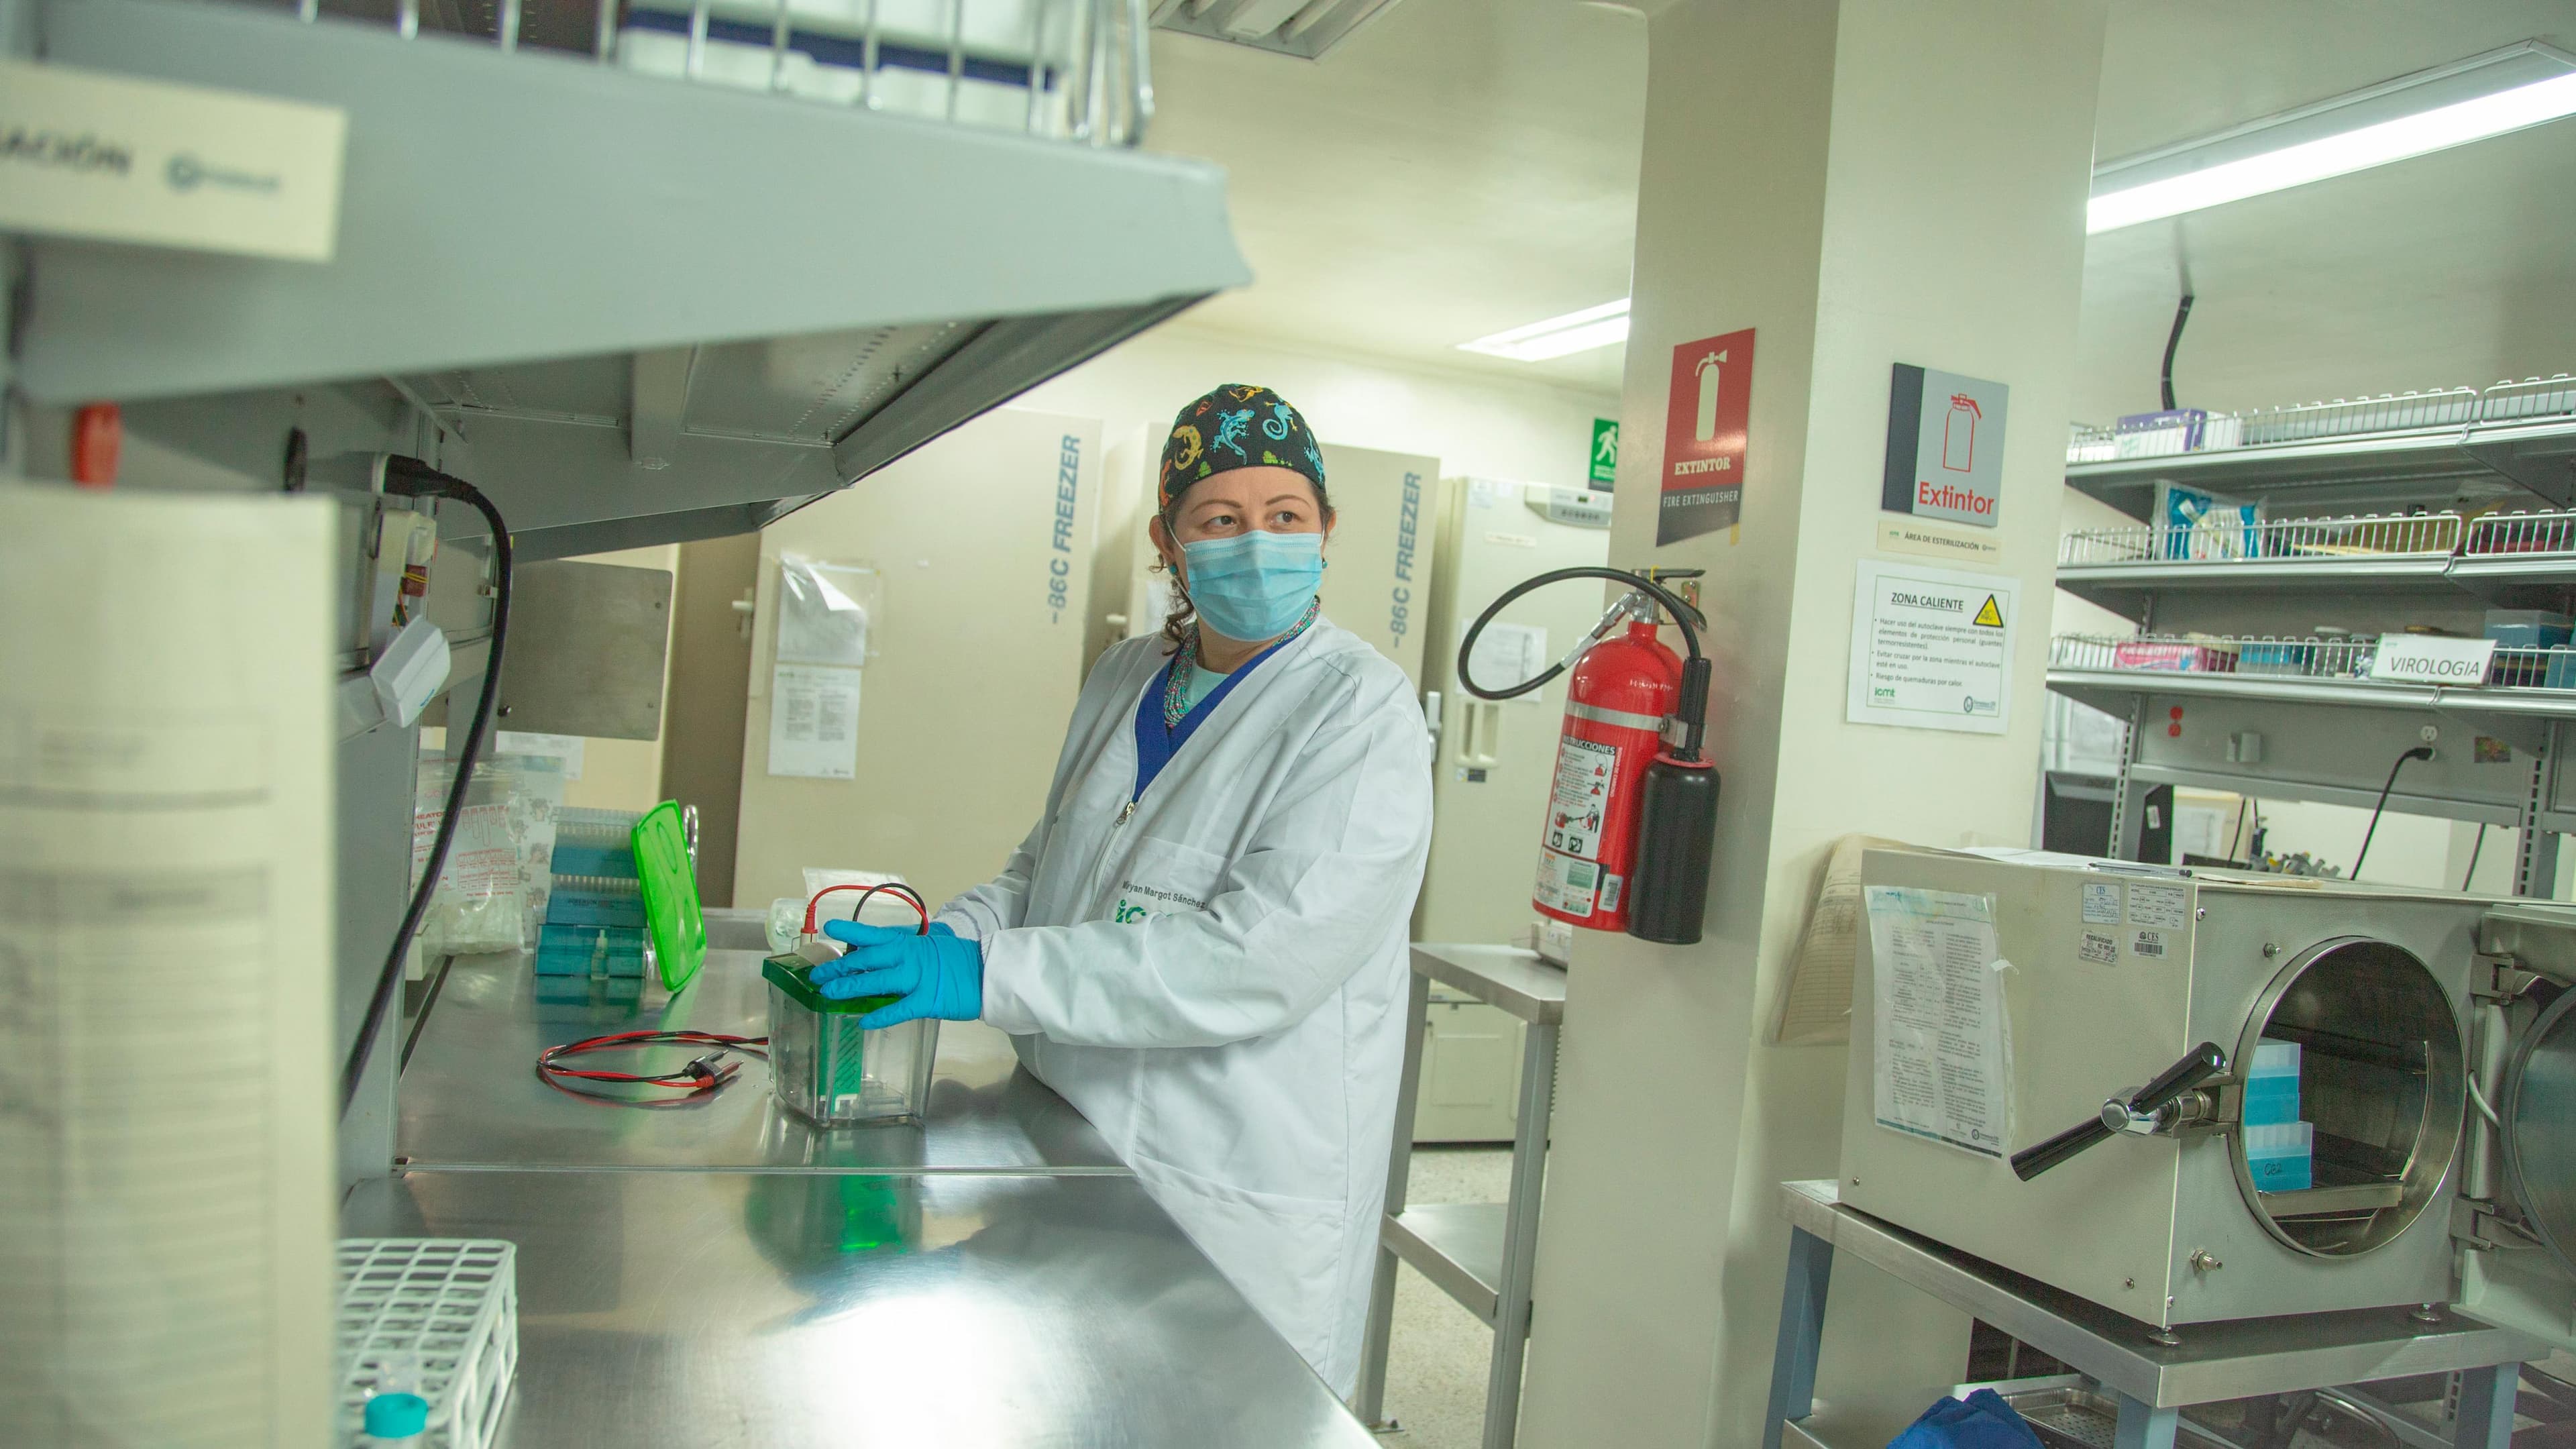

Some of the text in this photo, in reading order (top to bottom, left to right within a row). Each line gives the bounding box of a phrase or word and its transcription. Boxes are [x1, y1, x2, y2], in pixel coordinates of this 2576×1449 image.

[1674, 457, 1731, 476] EXTINTOR
[1052, 433, 1081, 553] FREEZER
[1663, 490, 1739, 508] FIRE EXTINGUISHER
[1918, 481, 1995, 515] Extintor
[1395, 472, 1422, 582] FREEZER
[1904, 531, 1921, 542] ÁREA
[1923, 536, 1931, 544] DE
[1932, 538, 1980, 551] ESTERILIZACIÓN
[1891, 592, 1964, 610] ZONA CALIENTE
[1878, 629, 1907, 637] elementos
[1921, 633, 1949, 642] protección
[1979, 639, 2002, 647] (guantes
[1945, 626, 1966, 634] siempre
[1943, 657, 1968, 666] mientras
[1975, 661, 2000, 669] autoclave
[2390, 656, 2480, 676] VIROLOGIA
[1876, 672, 1894, 682] Riesgo
[1902, 676, 1937, 684] quemaduras
[1874, 687, 1895, 698] icmt
[1144, 885, 1171, 901] Margot
[1173, 893, 1207, 908] Sánchez
[1116, 899, 1147, 924] ic
[2086, 933, 2113, 945] RECALIFICADO
[2147, 932, 2159, 942] CES
